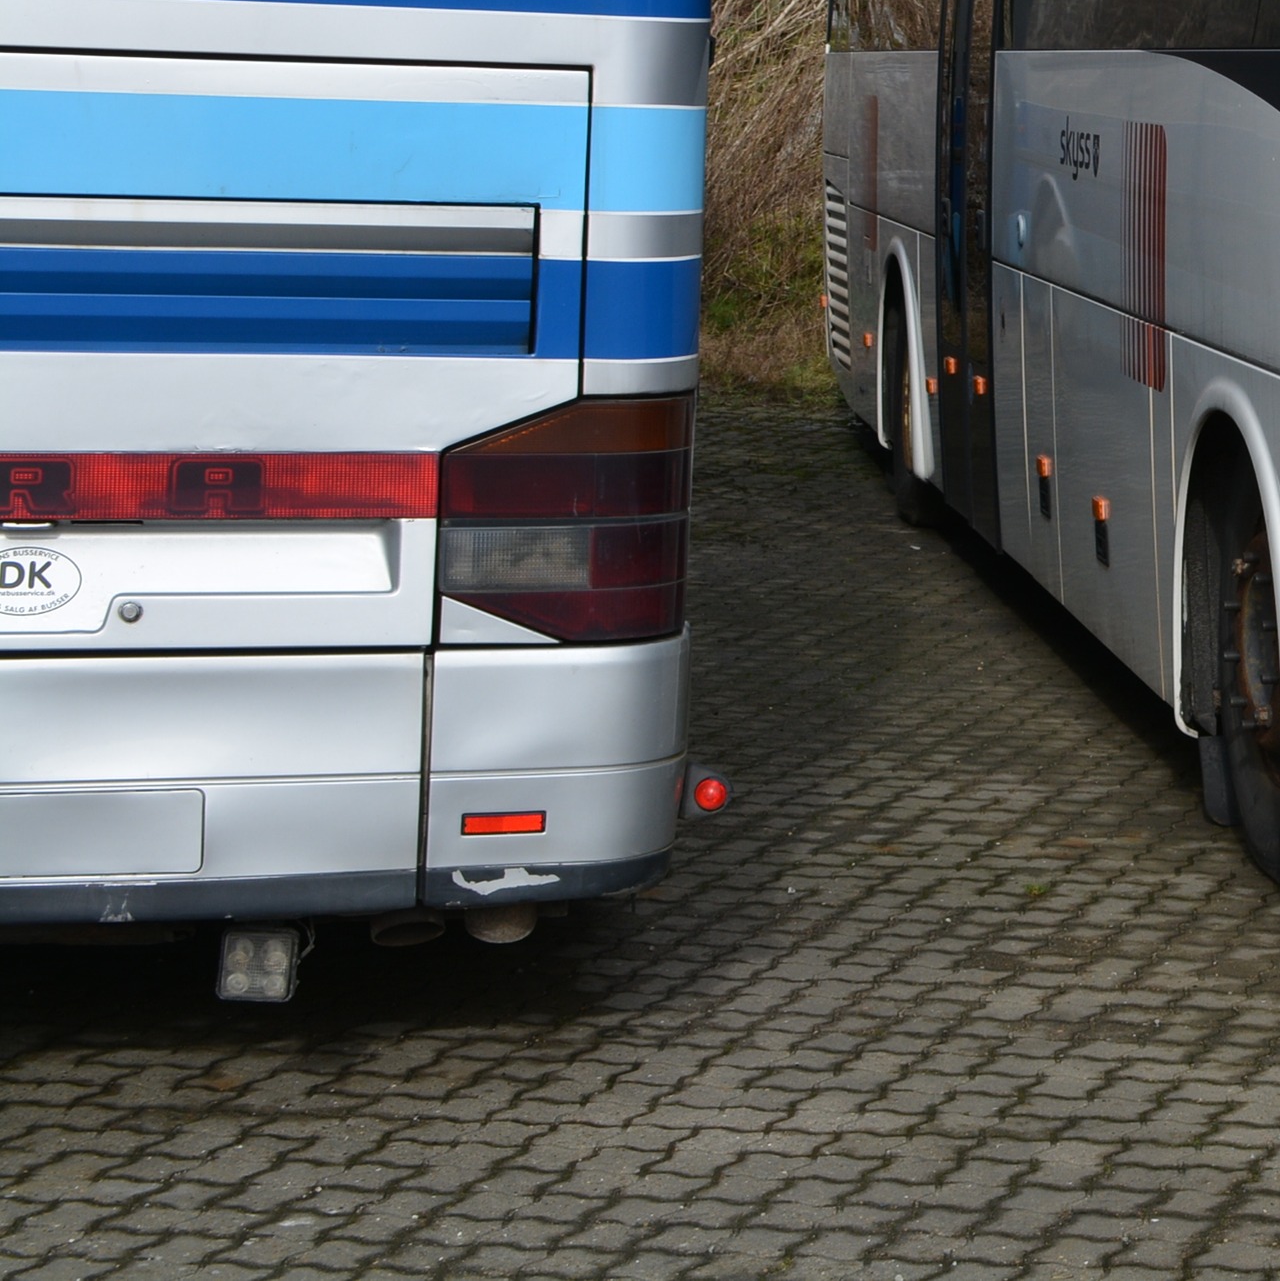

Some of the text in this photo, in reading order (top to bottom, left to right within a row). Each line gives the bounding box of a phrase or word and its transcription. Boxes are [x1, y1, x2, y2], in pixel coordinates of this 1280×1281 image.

[1060, 115, 1091, 181] skyss
[13, 549, 60, 561] BUSSERVICE
[0, 561, 52, 589] DK
[4, 605, 26, 613] SALG
[41, 593, 70, 610] BUSSER
